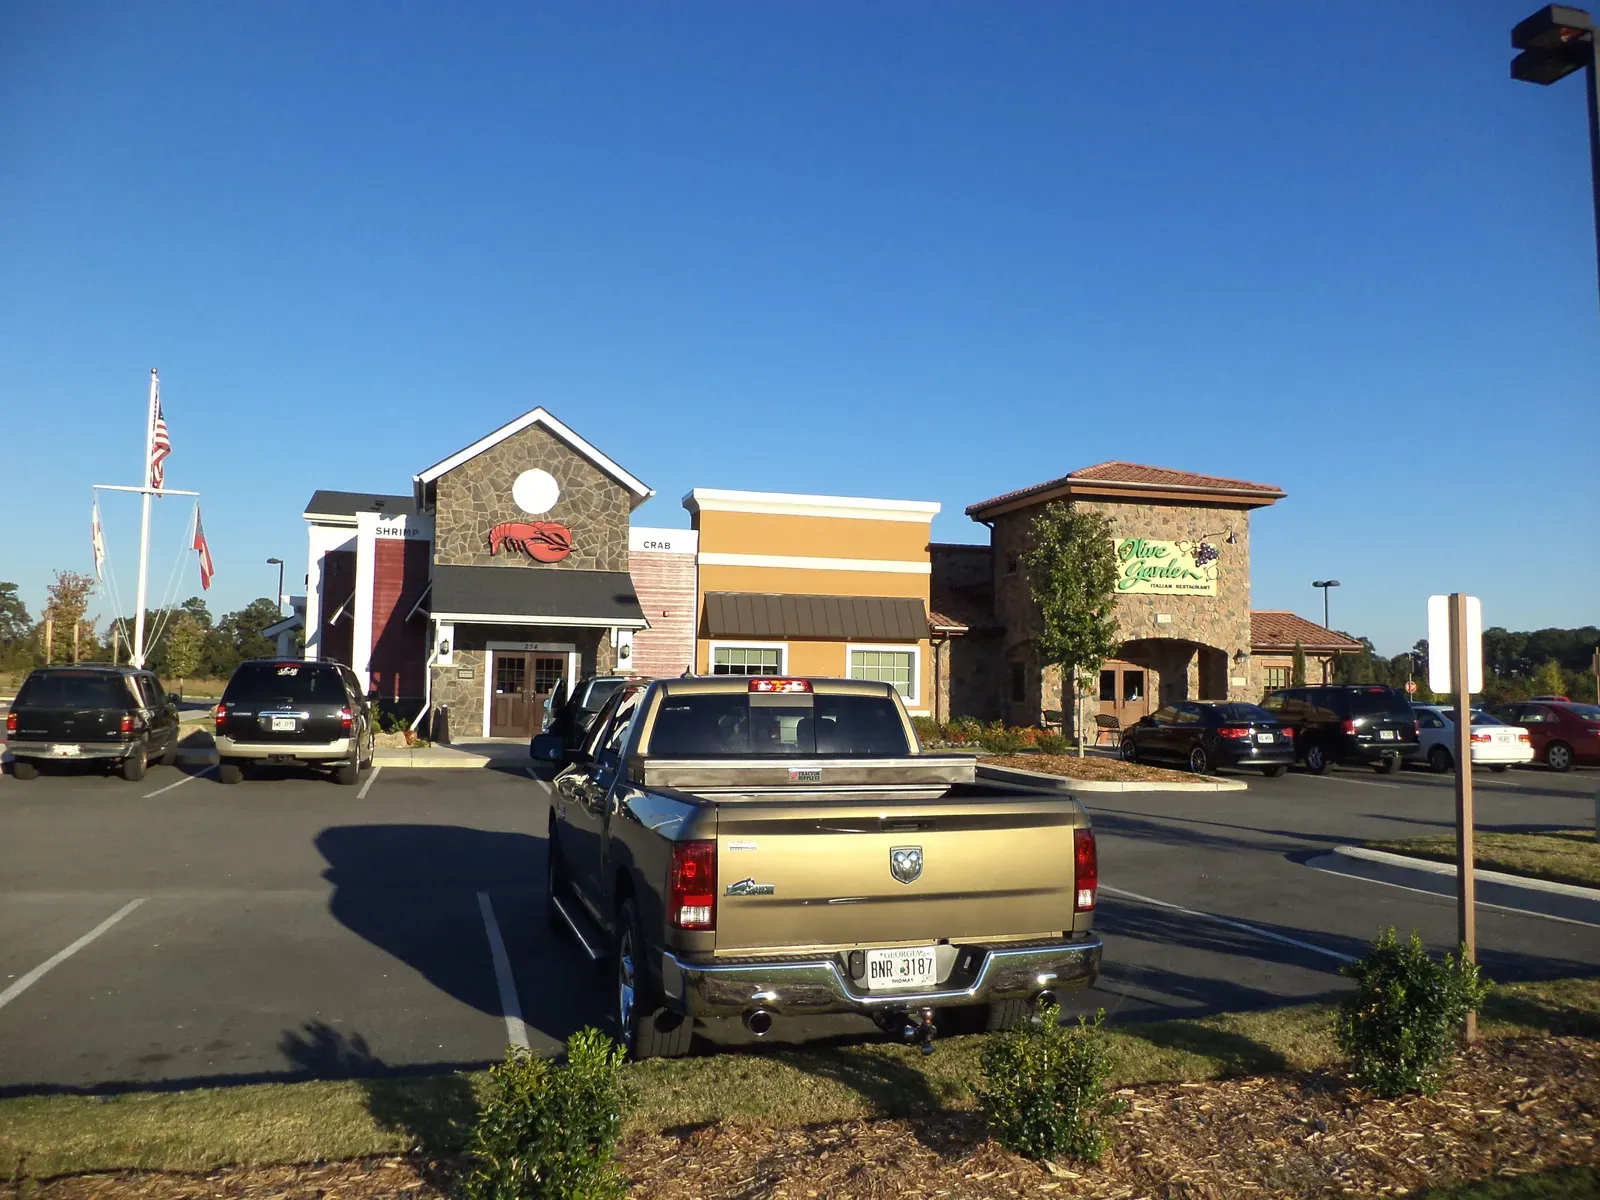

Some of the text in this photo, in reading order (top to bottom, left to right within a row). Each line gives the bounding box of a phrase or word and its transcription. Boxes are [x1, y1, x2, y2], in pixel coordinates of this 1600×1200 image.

[375, 526, 420, 538] SHRIMP
[643, 541, 671, 550] CRAB
[1118, 537, 1172, 560] Olive
[1118, 557, 1203, 590] Garden
[884, 950, 922, 958] GEORGIA
[871, 958, 932, 978] BNR 3187
